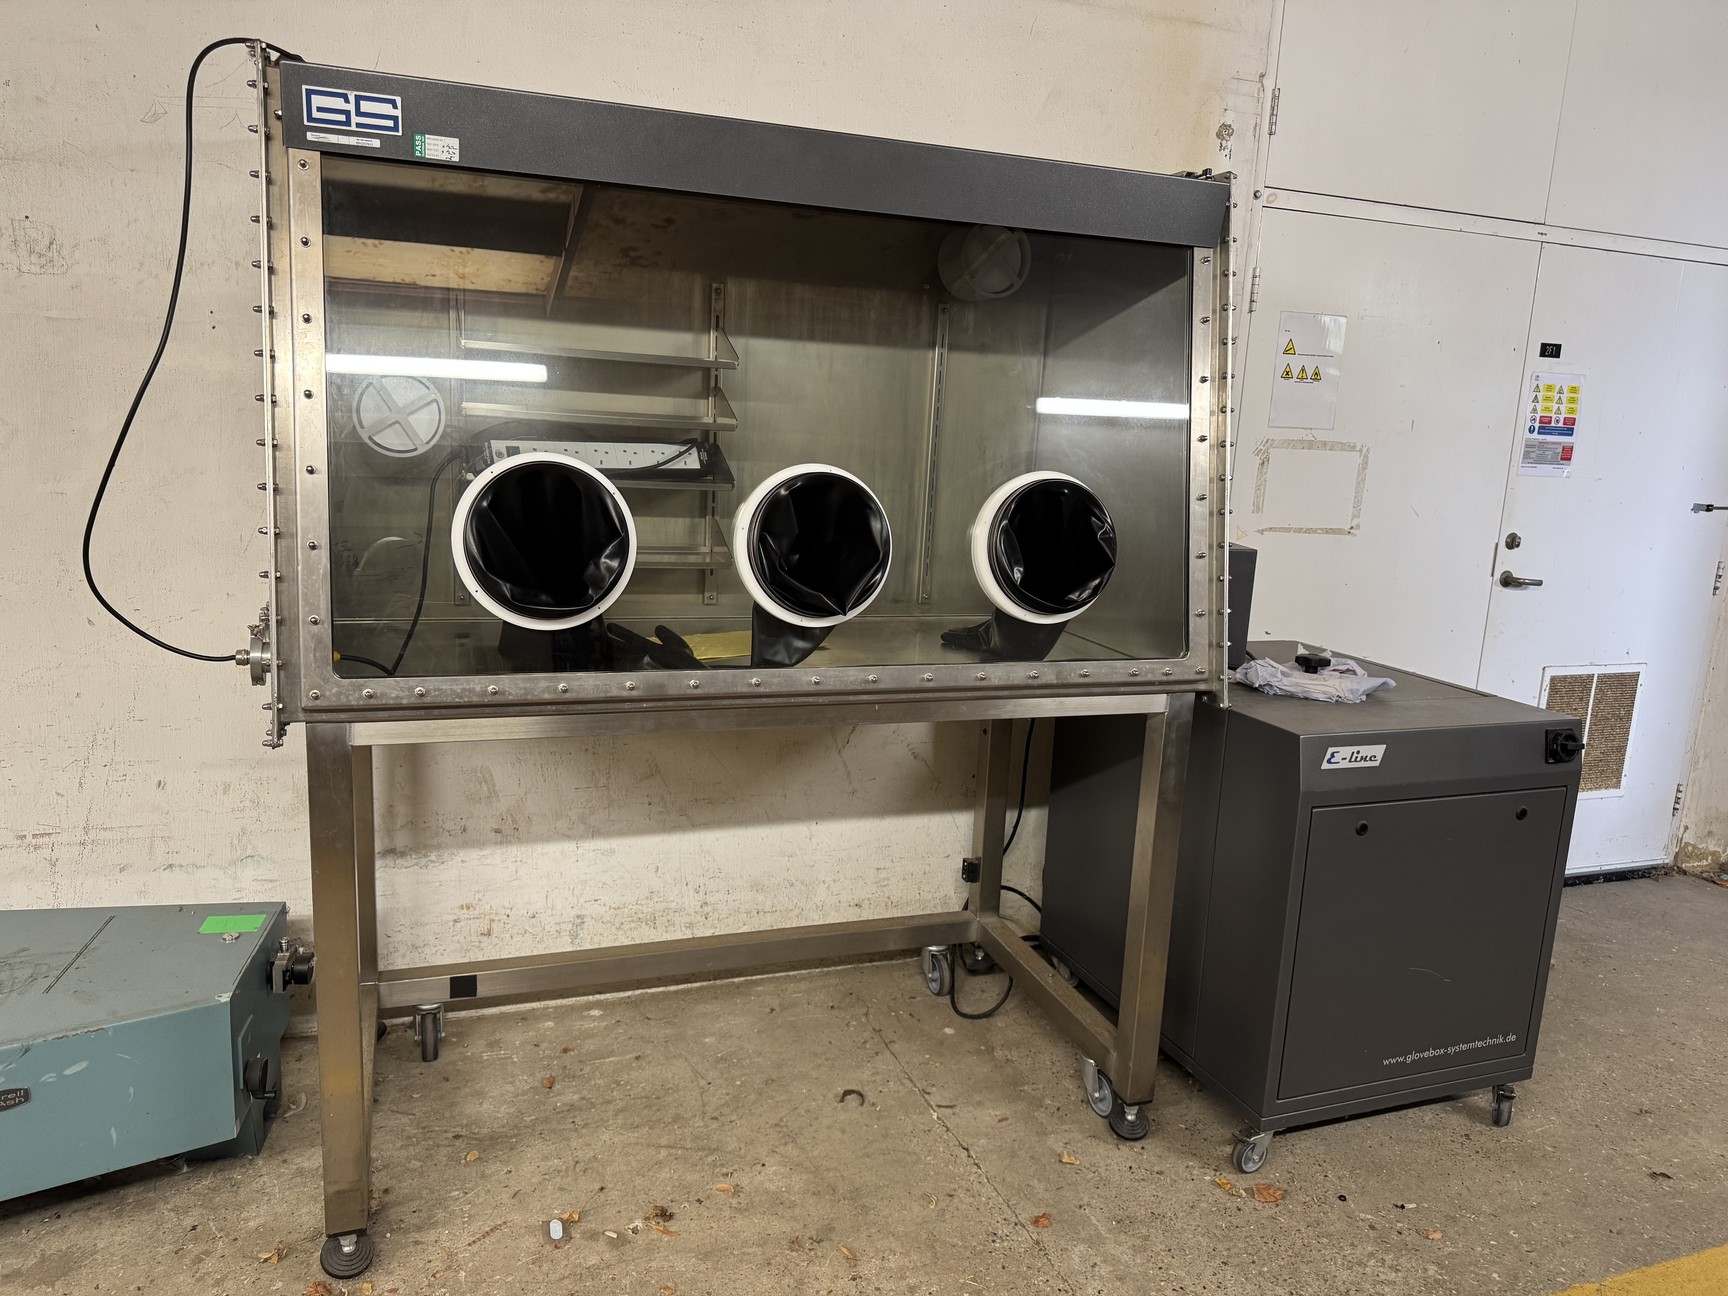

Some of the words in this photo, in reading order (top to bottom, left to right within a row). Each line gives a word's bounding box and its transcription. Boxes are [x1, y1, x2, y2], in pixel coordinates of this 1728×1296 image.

[305, 88, 400, 133] GS
[1544, 345, 1557, 356] 2F1
[1326, 750, 1379, 765] E-line
[1382, 1032, 1517, 1066] www.glovebox-systemtechnik.de
[1, 1089, 24, 1101] rell
